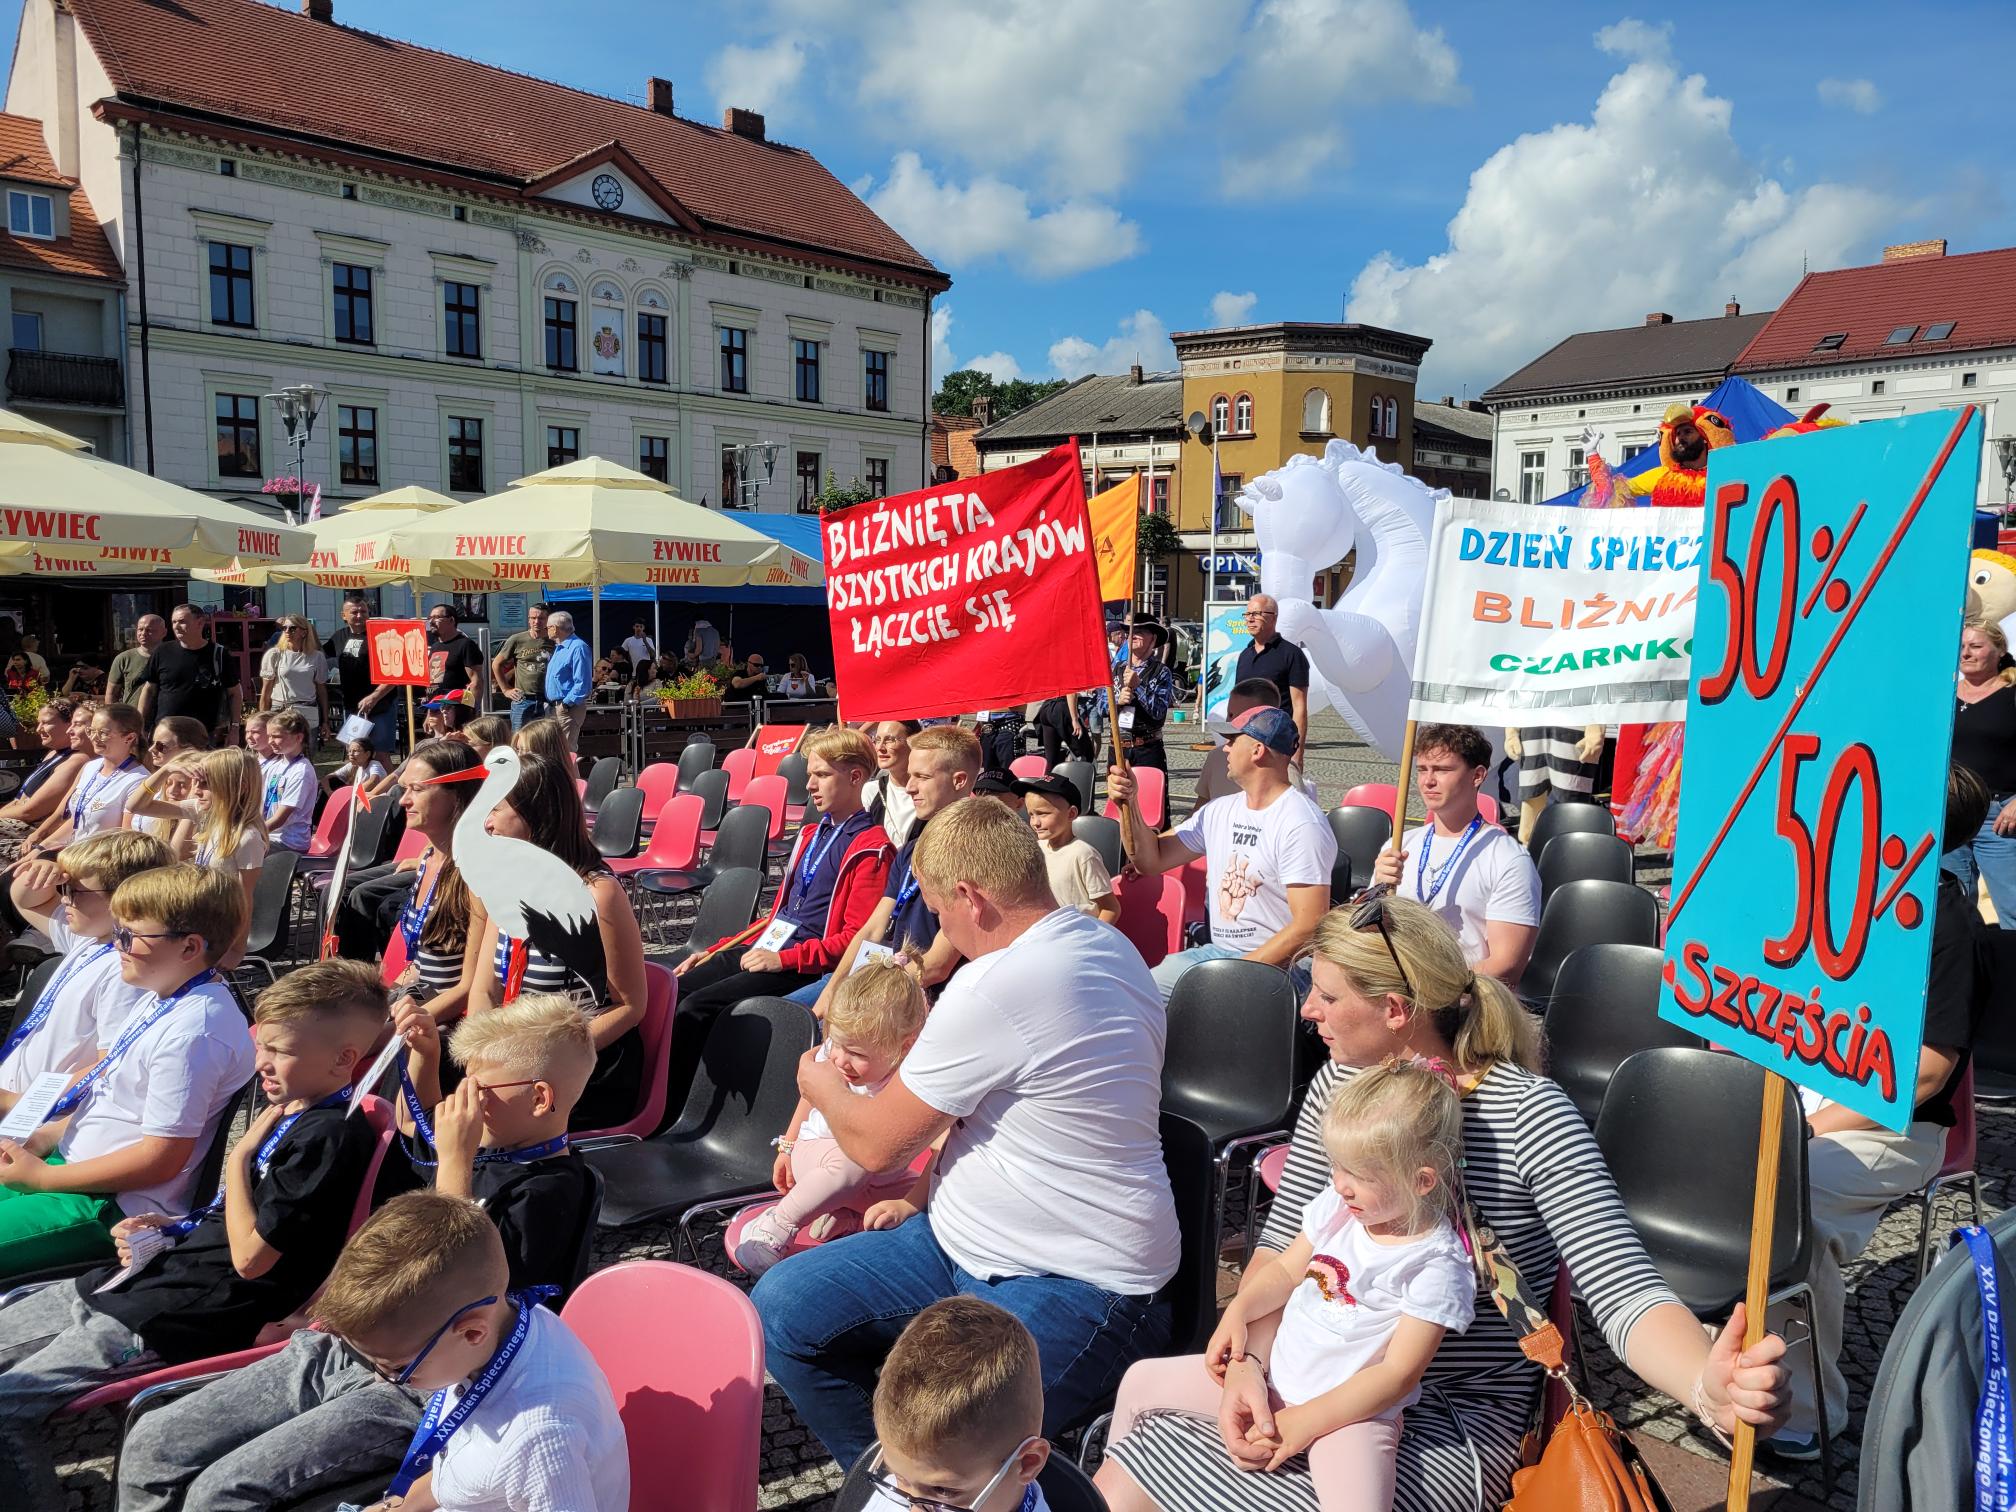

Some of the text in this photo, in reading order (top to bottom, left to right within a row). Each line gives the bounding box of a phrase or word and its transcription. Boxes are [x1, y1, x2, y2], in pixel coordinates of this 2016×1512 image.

[0, 508, 101, 541] YWIEC
[237, 526, 281, 557] ŻYWIEC
[455, 535, 527, 557] ŻYWIEC
[653, 539, 721, 563] ŻYWIEC
[965, 510, 1086, 584] KRAJÓW
[1459, 525, 1572, 570] DZIEŃ
[1699, 474, 1868, 706] 50%
[1233, 832, 1257, 846] TATO
[1764, 734, 1936, 981] 50%
[76, 1075, 91, 1090] XXV
[408, 1093, 421, 1112] XXV
[1980, 1264, 1998, 1307] XXV
[433, 1418, 456, 1442] XXV
[453, 1393, 479, 1421] Dzień
[476, 1322, 526, 1393] Spieczonego
[1976, 1367, 2001, 1487] Spieczonego
